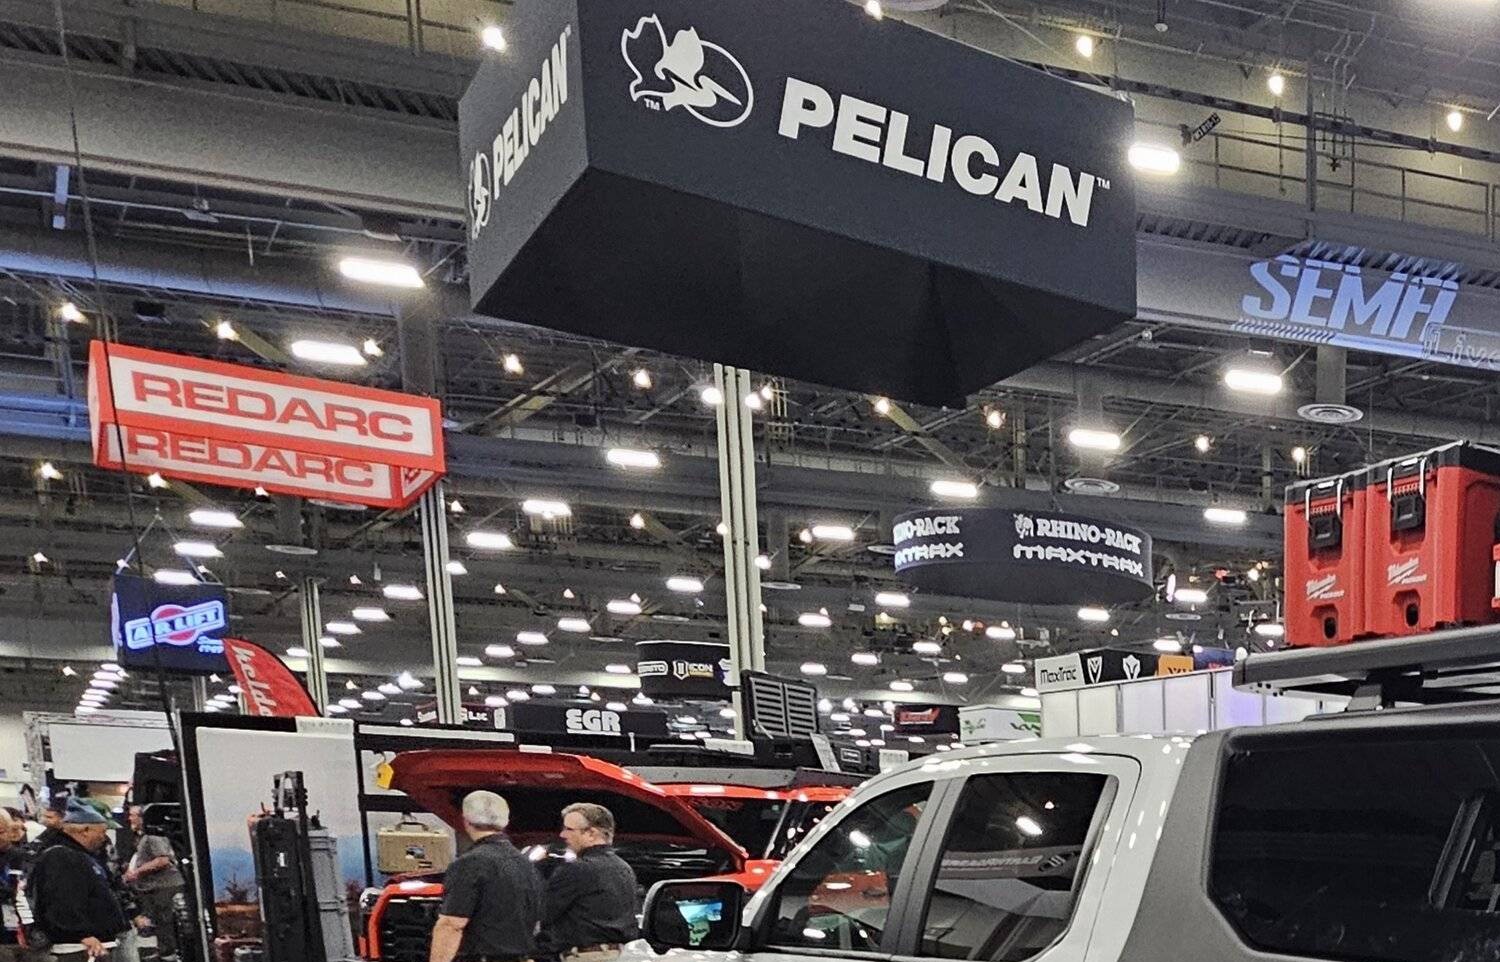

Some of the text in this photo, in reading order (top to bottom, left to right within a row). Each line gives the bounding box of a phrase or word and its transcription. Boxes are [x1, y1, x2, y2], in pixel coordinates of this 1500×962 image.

[493, 32, 568, 200] PELICAN
[778, 77, 1095, 227] PELICAN
[131, 371, 414, 442] REDARC
[126, 428, 374, 488] REDARC
[1013, 544, 1144, 577] MAXTRAX
[1036, 518, 1142, 554] RHINO-RACK
[566, 708, 621, 732] EGR
